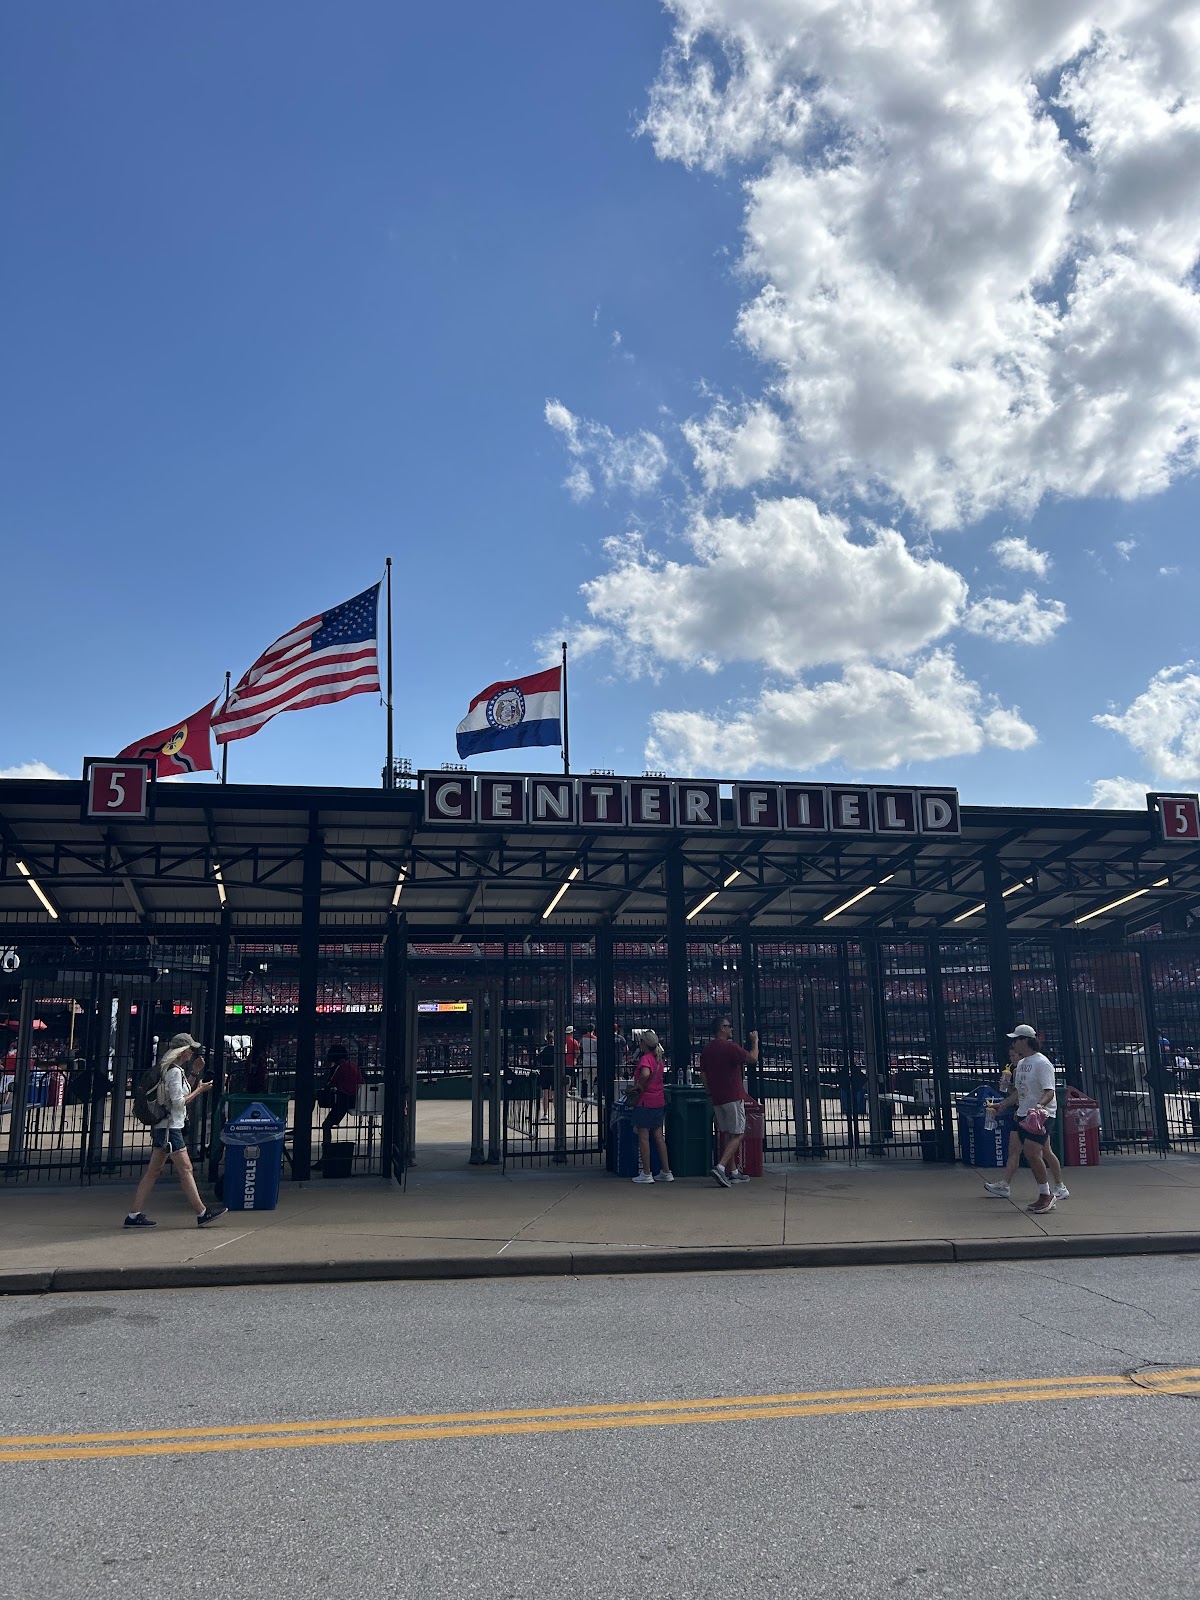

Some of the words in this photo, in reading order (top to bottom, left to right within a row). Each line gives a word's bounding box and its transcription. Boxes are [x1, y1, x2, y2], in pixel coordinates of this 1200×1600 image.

[107, 772, 126, 808] 5
[435, 781, 713, 822] CENTER
[748, 791, 952, 829] FIELD
[1175, 804, 1189, 834] 5
[994, 1128, 1004, 1166] RECYCLE
[1078, 1126, 1087, 1165] RECYCLE
[243, 1159, 257, 1209] RECYCLE
